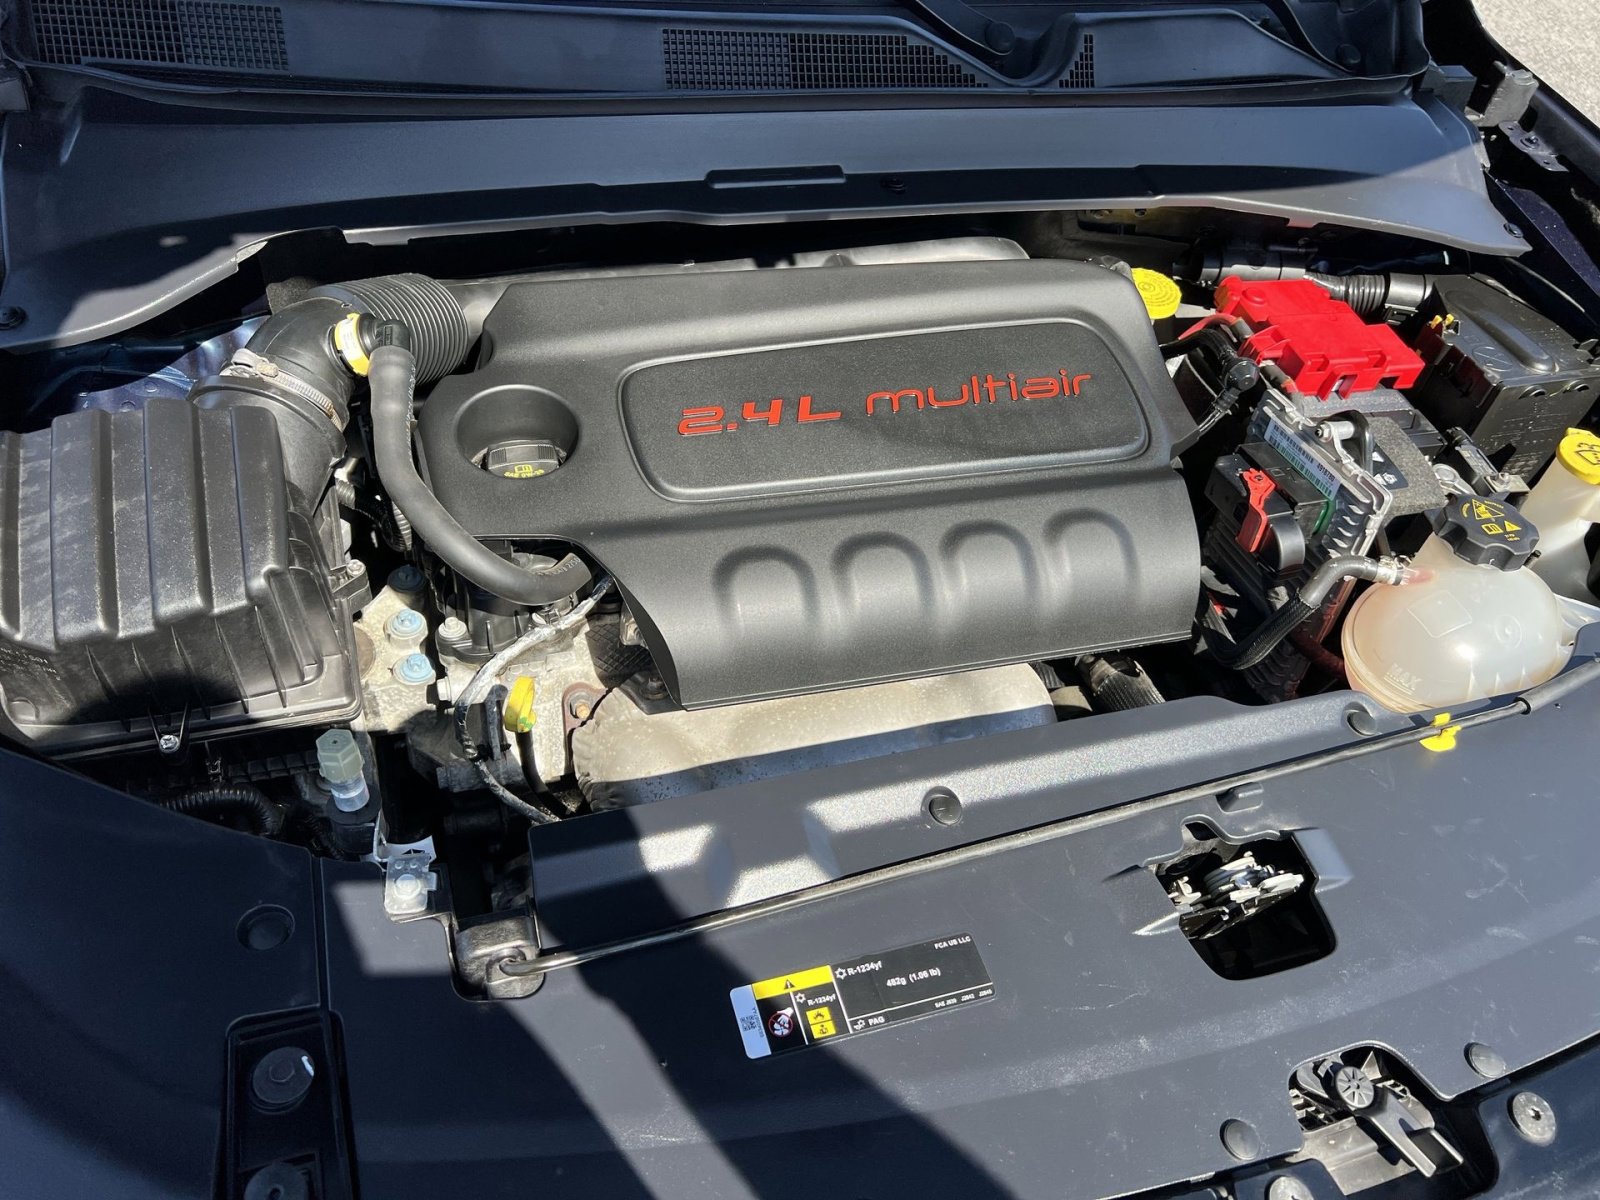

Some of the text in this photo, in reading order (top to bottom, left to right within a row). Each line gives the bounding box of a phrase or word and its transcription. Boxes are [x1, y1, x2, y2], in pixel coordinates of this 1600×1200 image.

[866, 369, 1092, 417] multiair
[934, 941, 948, 949] FCA
[847, 961, 882, 975] R-1234yf
[807, 994, 836, 1006] R-1234yf
[868, 1016, 885, 1025] PAG
